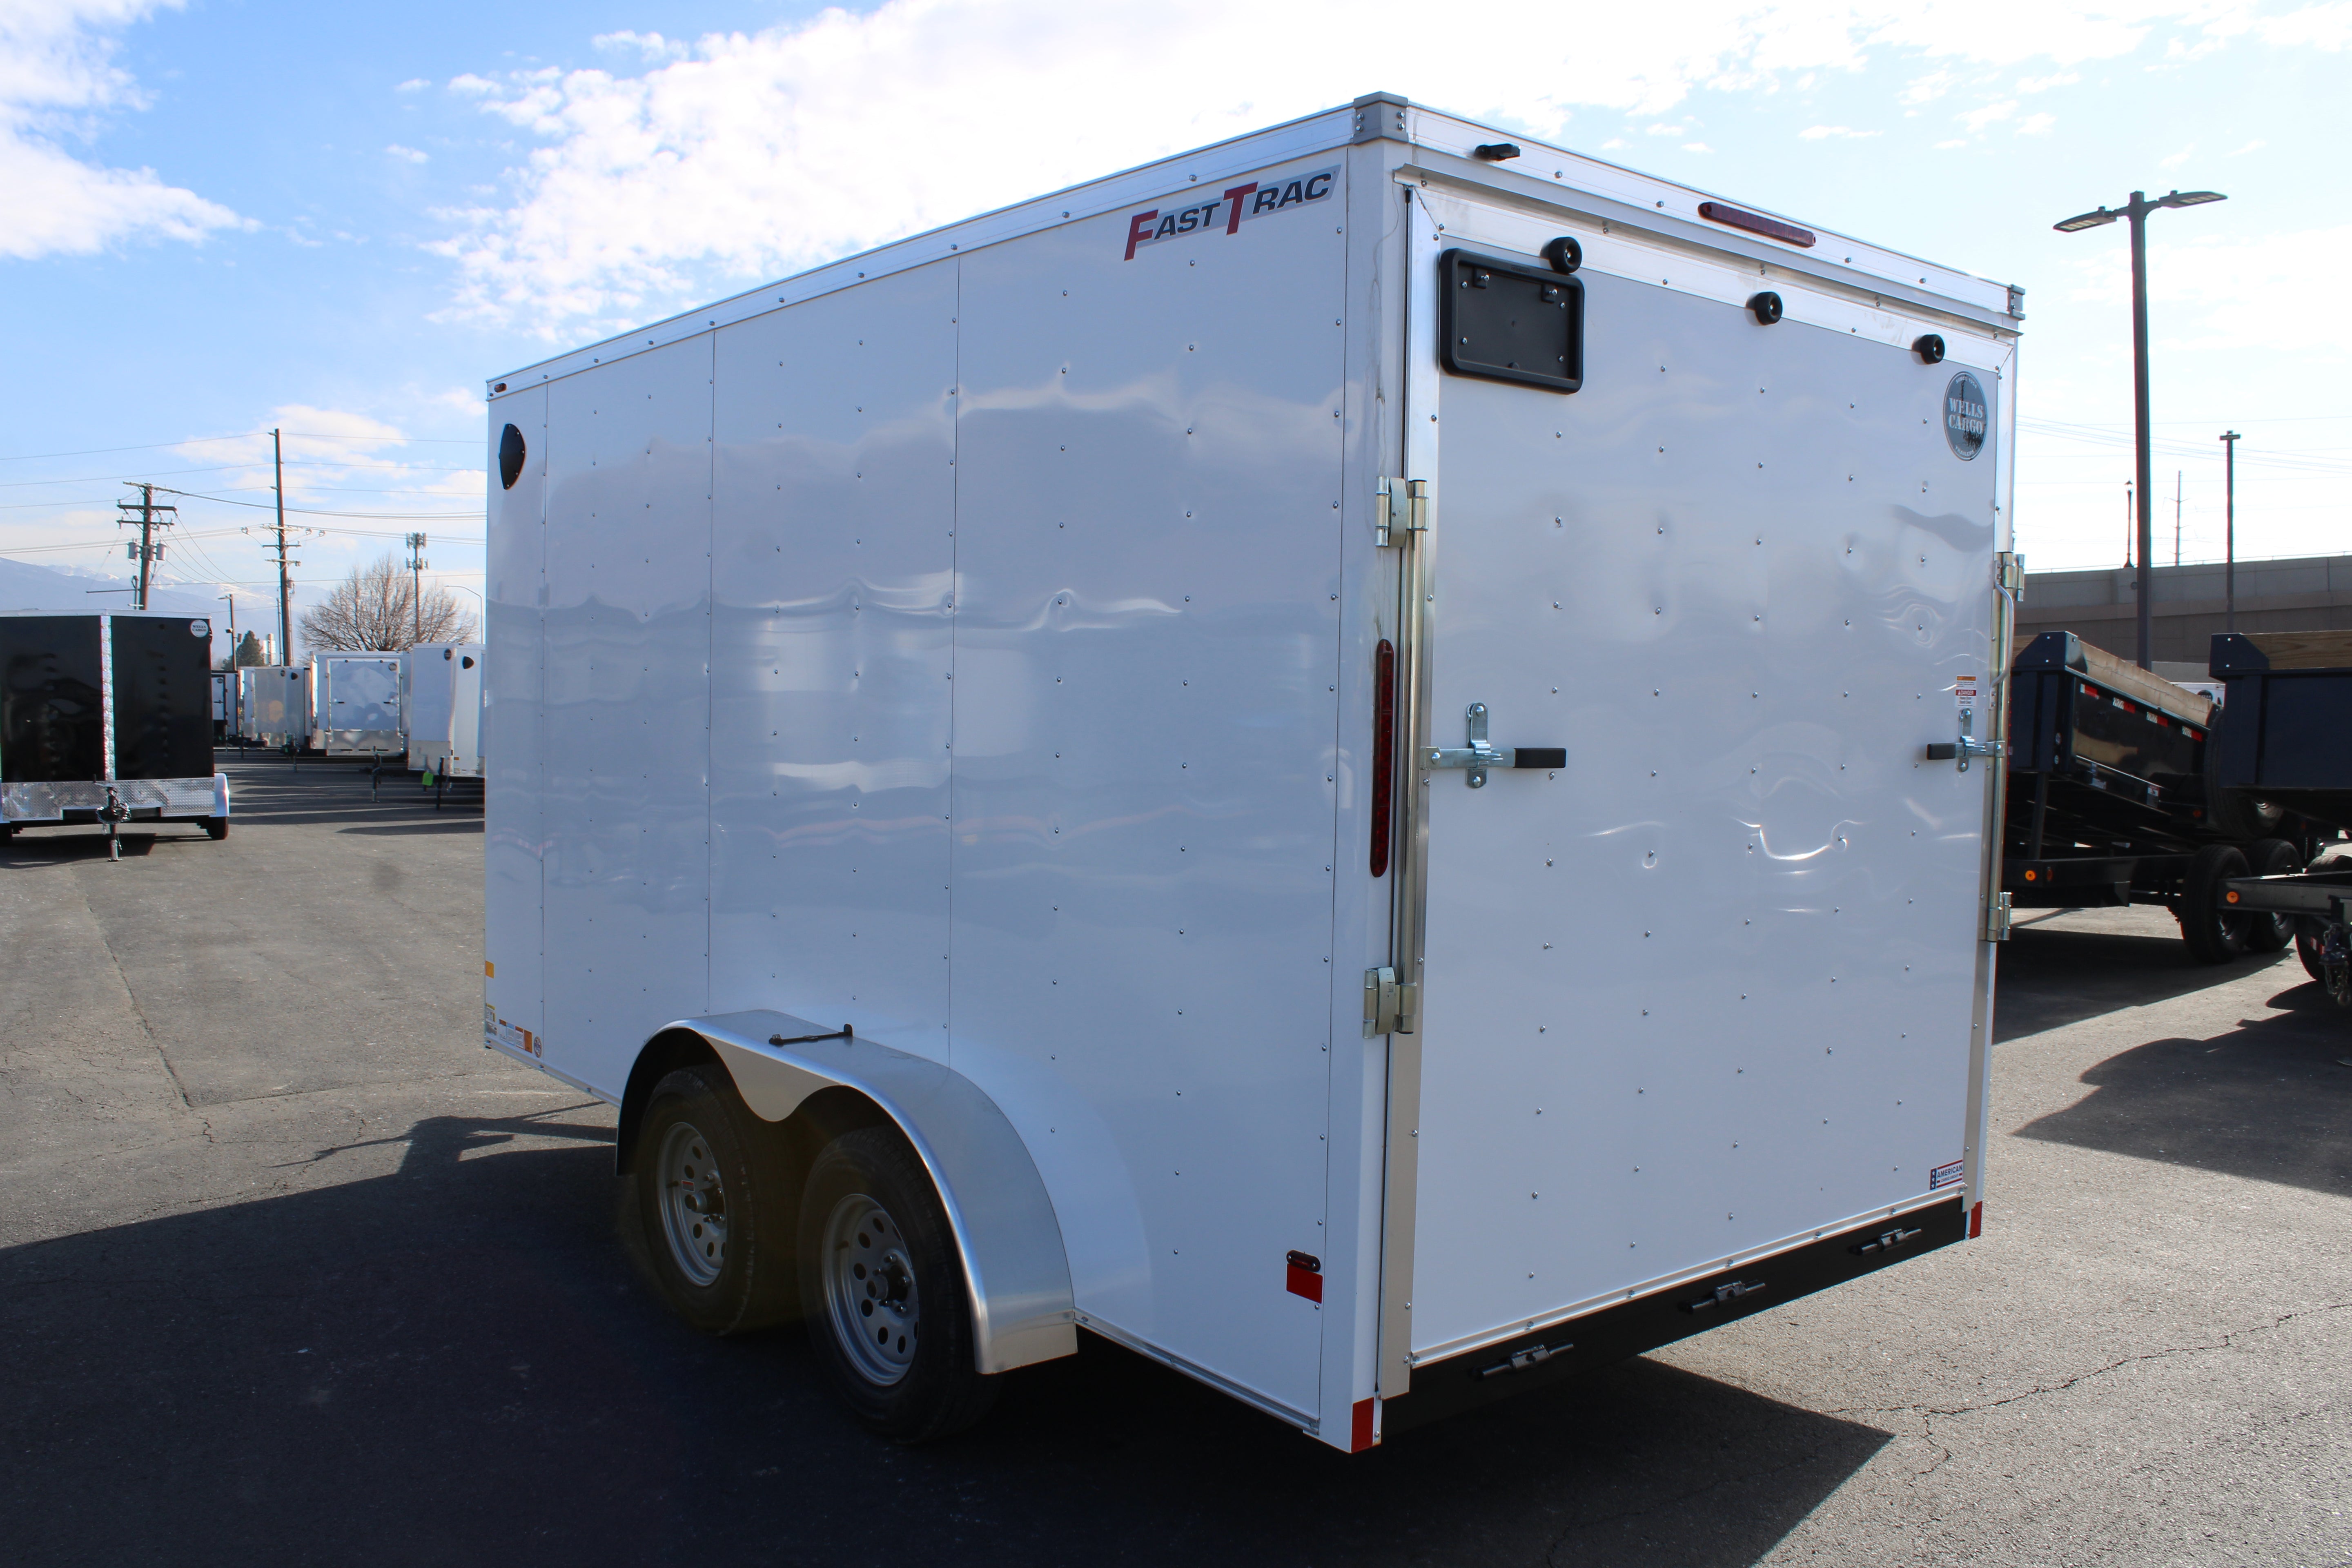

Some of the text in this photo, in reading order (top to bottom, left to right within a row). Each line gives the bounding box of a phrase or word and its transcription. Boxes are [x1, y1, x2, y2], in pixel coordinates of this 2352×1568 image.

[1124, 173, 1332, 261] FAST TRAC
[1949, 397, 1983, 419] WELLS
[1948, 414, 1982, 434] CARGO
[1938, 1164, 1962, 1178] AMERICAN
